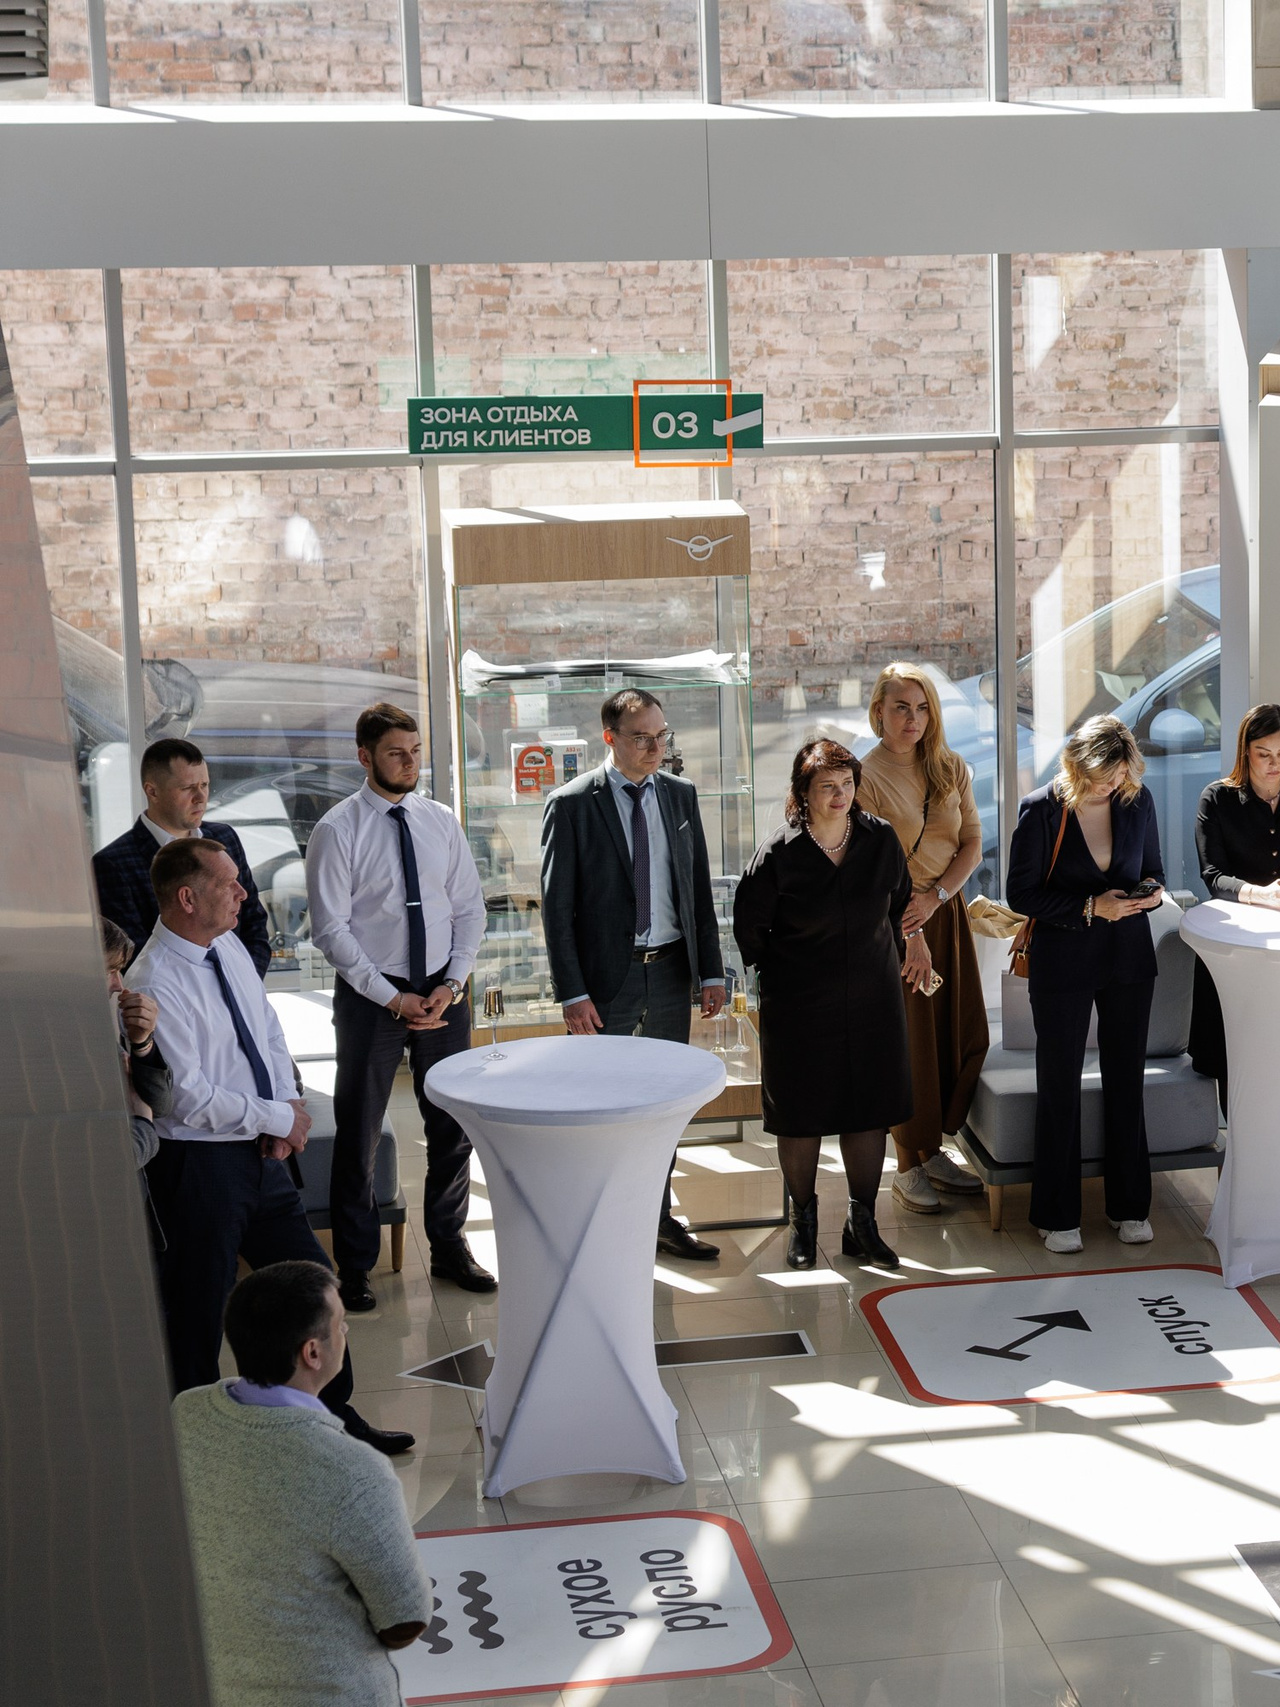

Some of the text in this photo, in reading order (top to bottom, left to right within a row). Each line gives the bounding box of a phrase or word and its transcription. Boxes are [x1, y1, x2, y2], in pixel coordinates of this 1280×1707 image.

[420, 405, 578, 425] ЗОНА ОТДЫХА
[652, 411, 699, 439] 03
[421, 428, 592, 450] ДЛЯ КЛИЕНТОВ
[1137, 1294, 1214, 1355] спуск
[557, 1558, 638, 1640] сухое
[639, 1549, 729, 1633] русло
